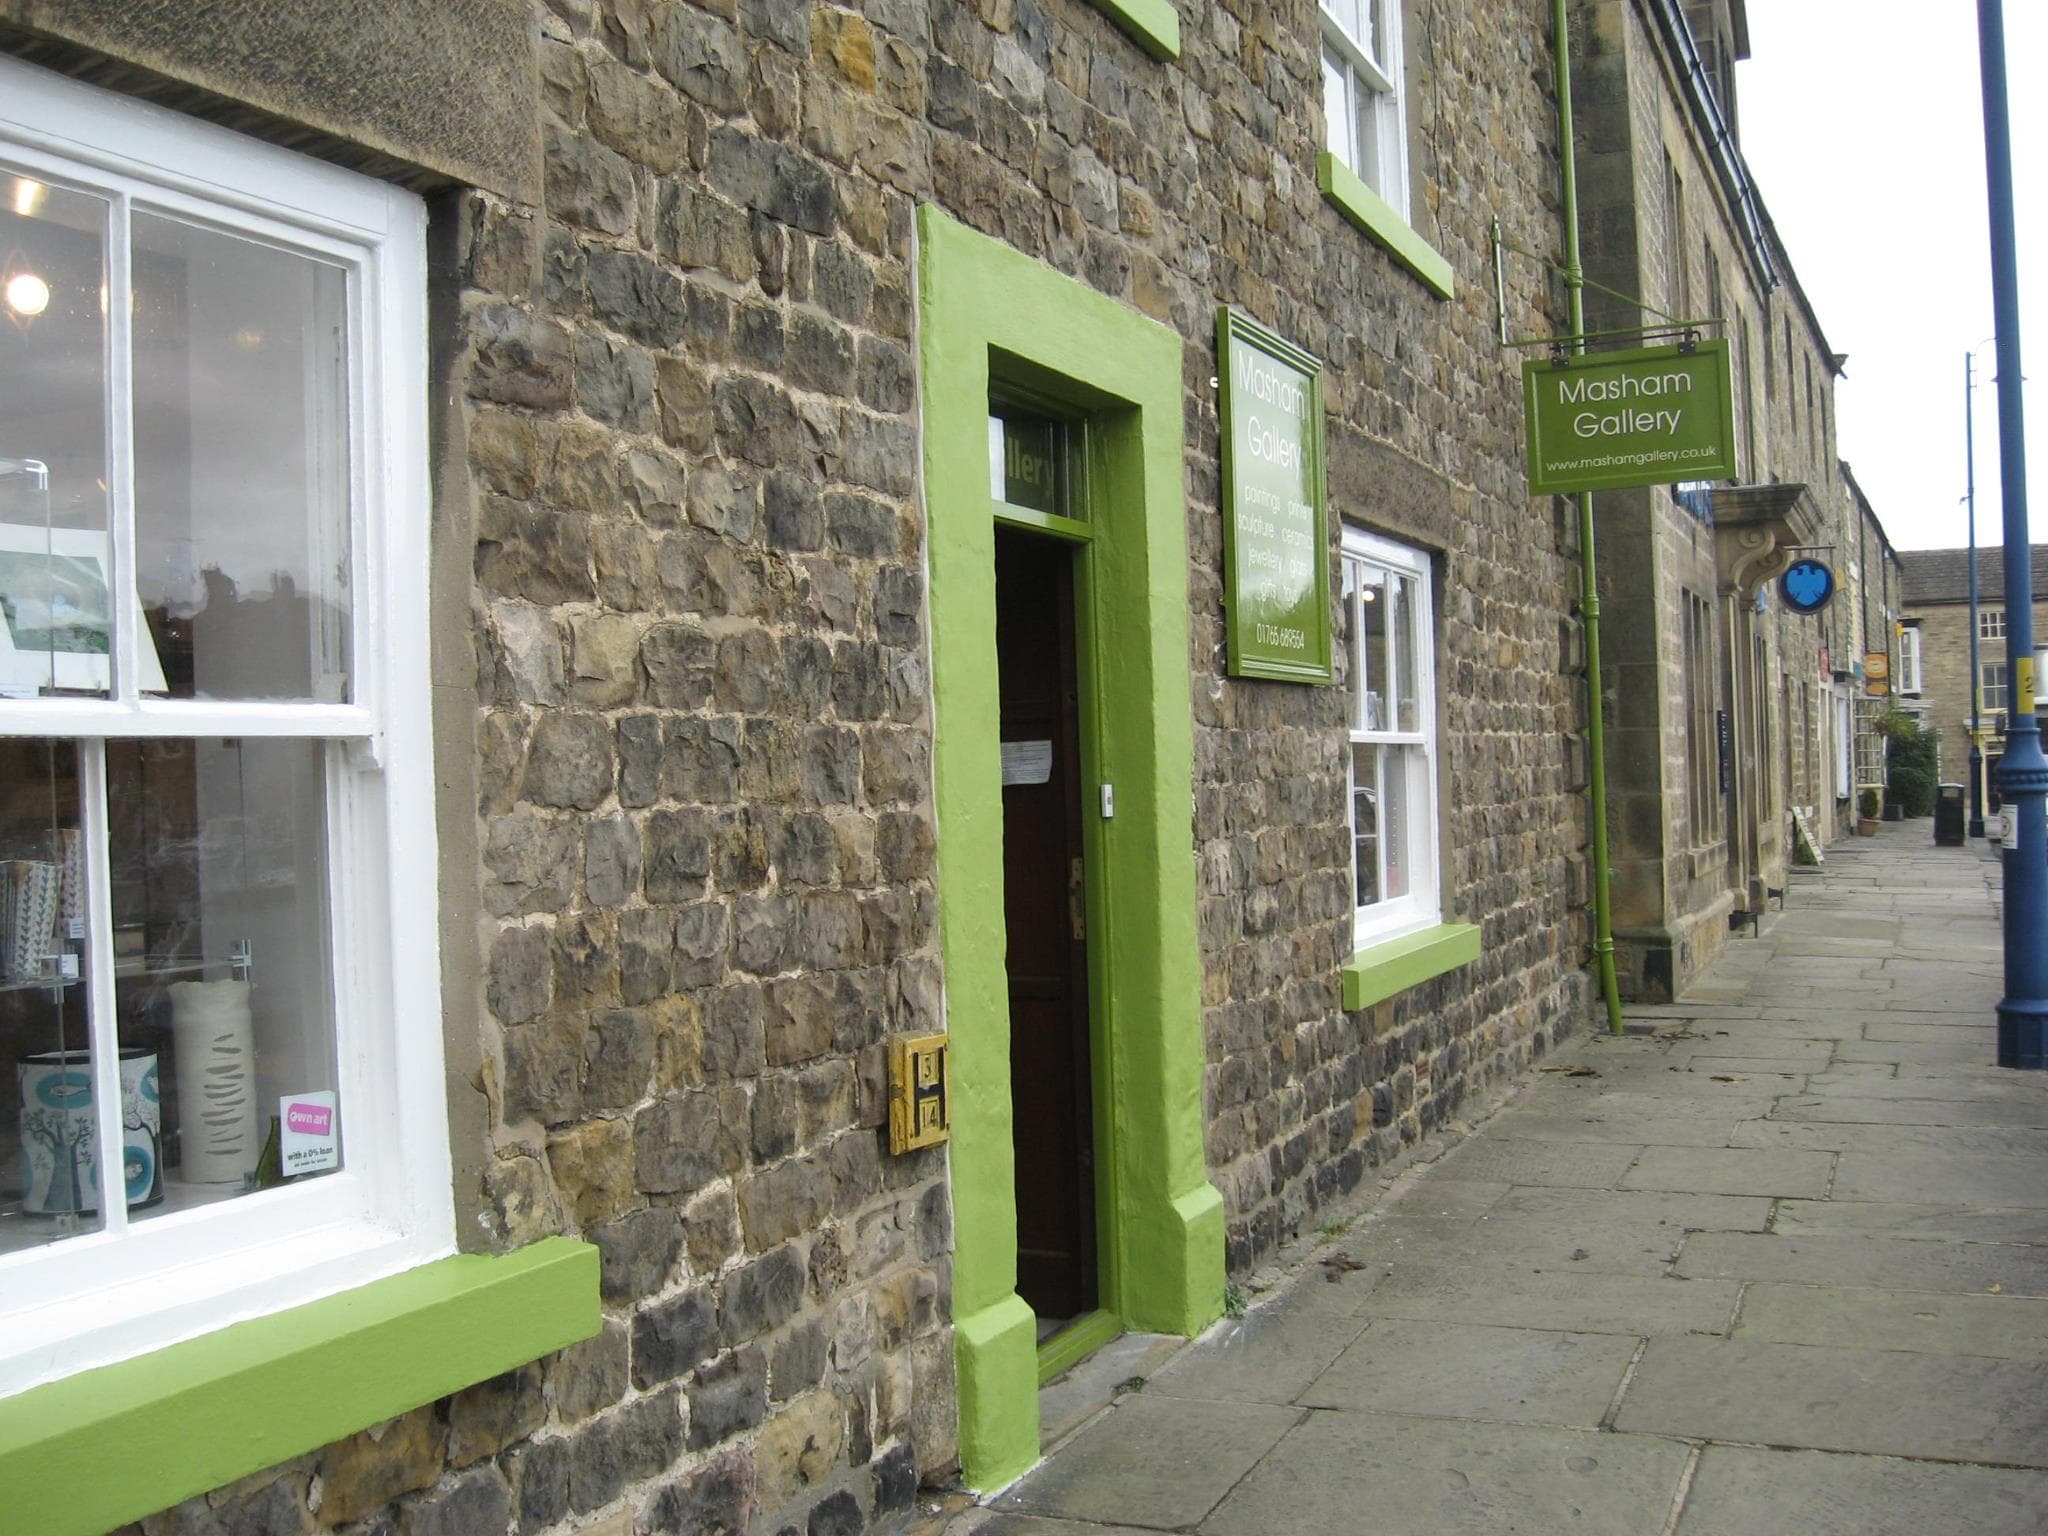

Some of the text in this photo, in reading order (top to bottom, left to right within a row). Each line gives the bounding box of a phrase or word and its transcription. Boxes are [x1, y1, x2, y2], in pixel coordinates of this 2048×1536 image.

[1238, 350, 1305, 421] Masham
[1558, 372, 1692, 405] Masham
[1573, 408, 1683, 439] Gallery
[1247, 415, 1302, 482] Gallery
[1546, 446, 1716, 471] www.mashamgallery.co.uk
[1244, 485, 1281, 514] paintings
[1237, 513, 1274, 538] sculpture
[1256, 623, 1280, 646] 01765
[289, 1112, 328, 1125] own art
